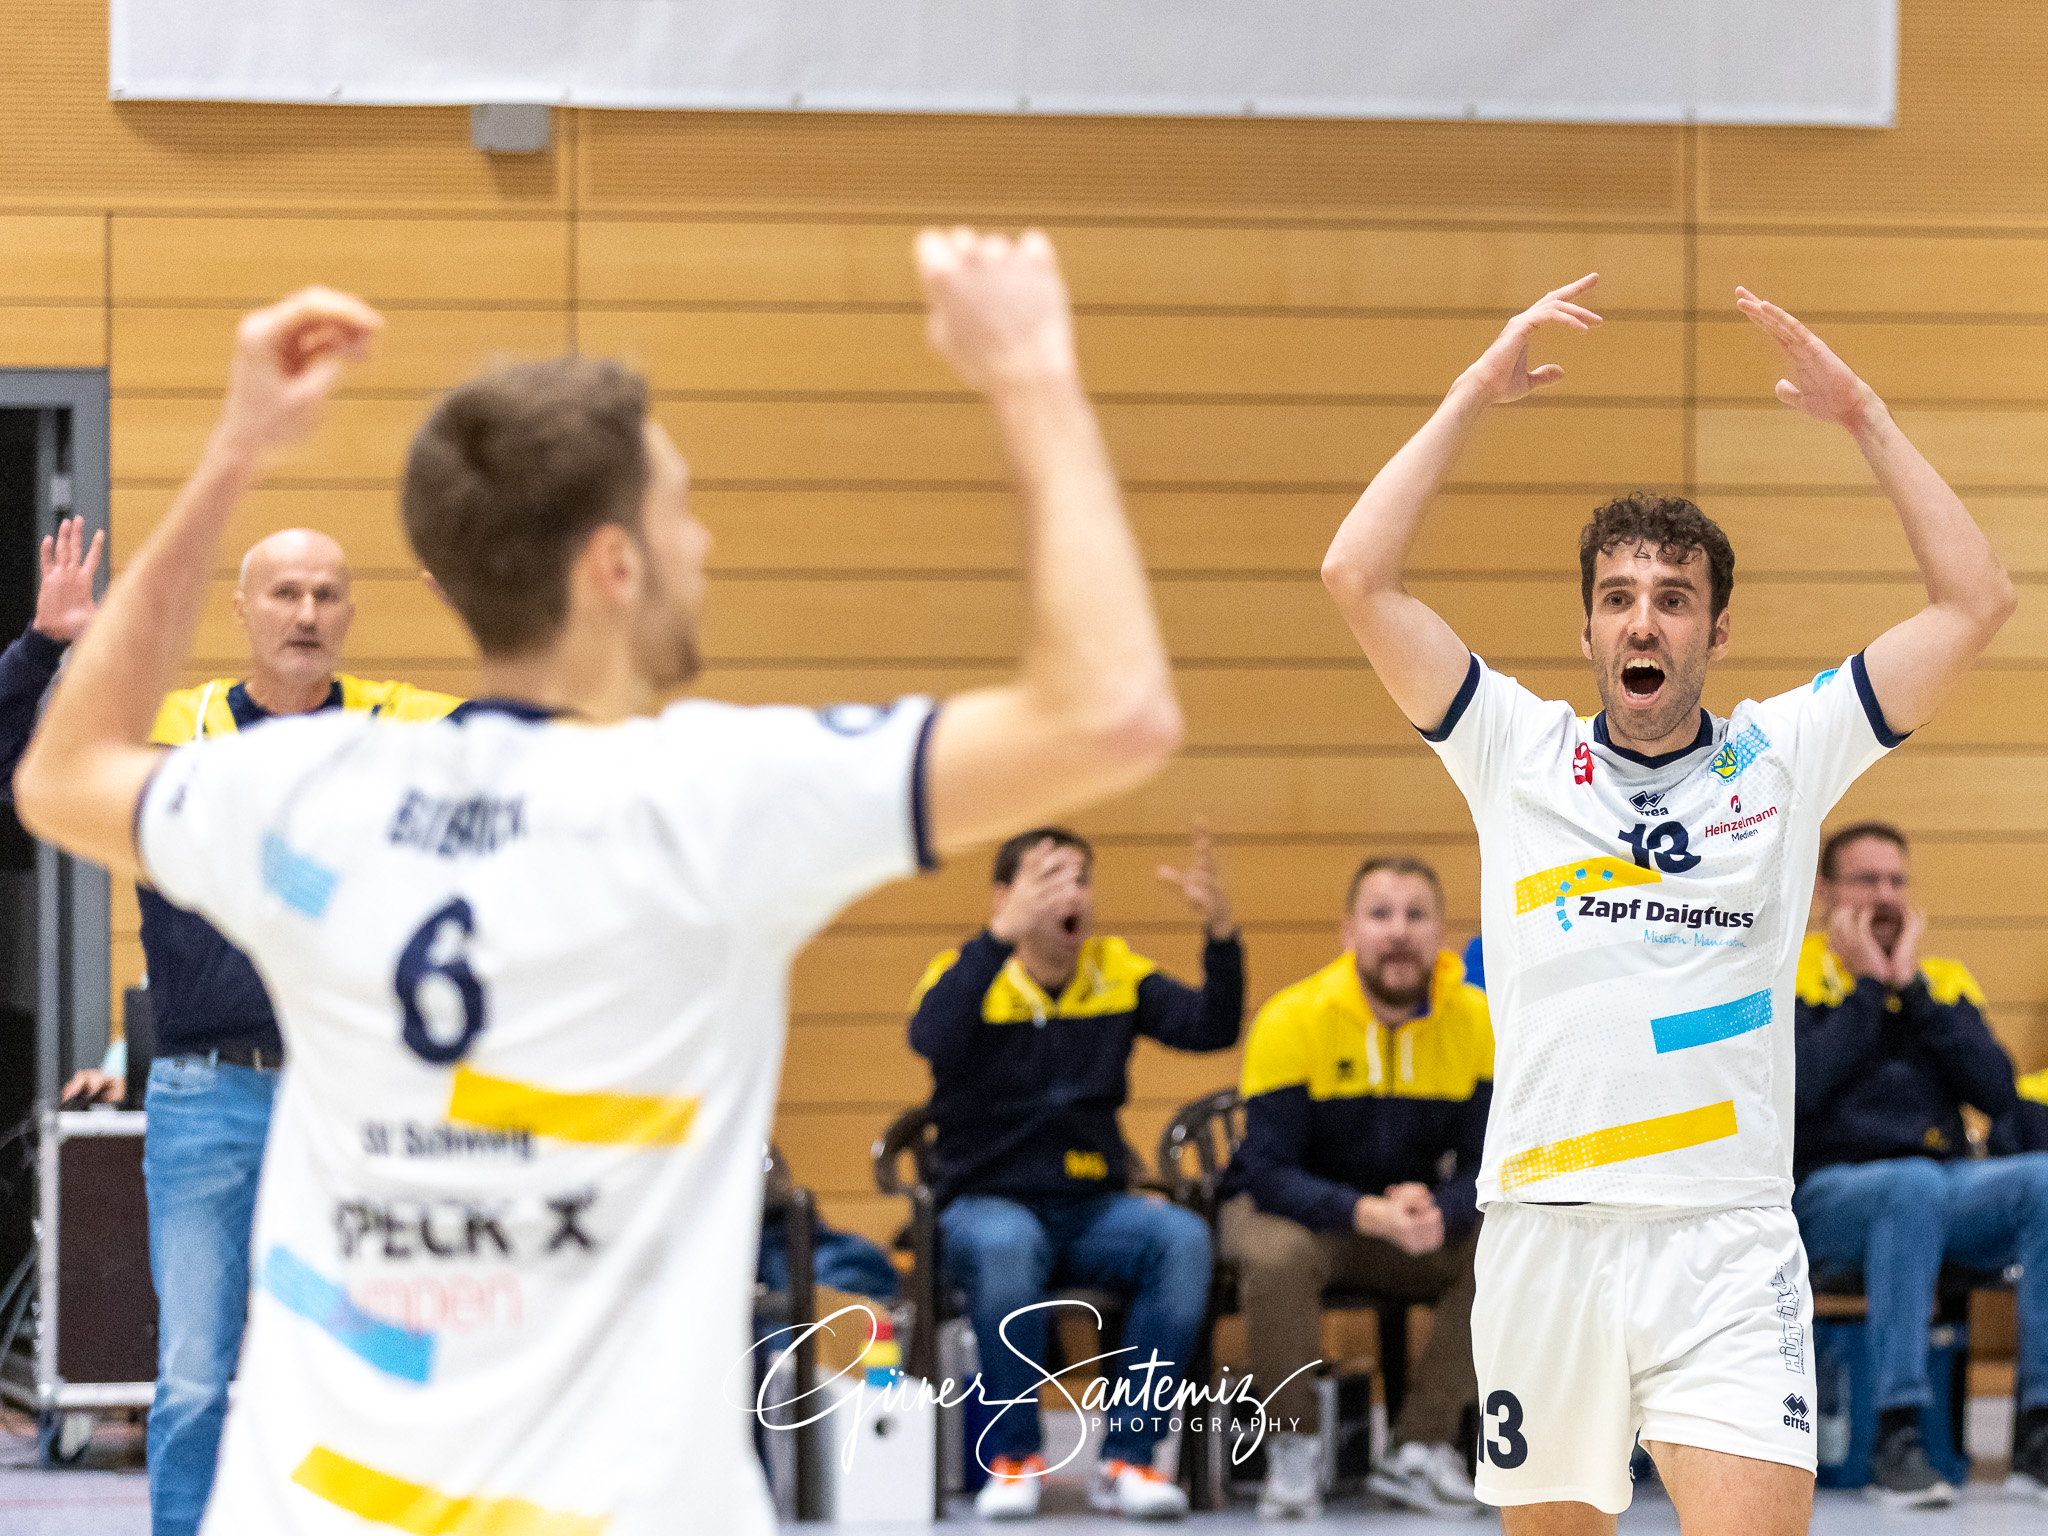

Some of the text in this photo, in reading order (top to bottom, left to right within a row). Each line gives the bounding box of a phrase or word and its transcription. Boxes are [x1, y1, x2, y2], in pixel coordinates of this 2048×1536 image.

[1705, 806, 1778, 838] Heinzelmann
[1731, 829, 1759, 842] Medien
[1618, 821, 1702, 874] 13
[1579, 896, 1754, 928] Zapf Daigfuss
[394, 894, 488, 1066] 6
[333, 1196, 513, 1260] PECK
